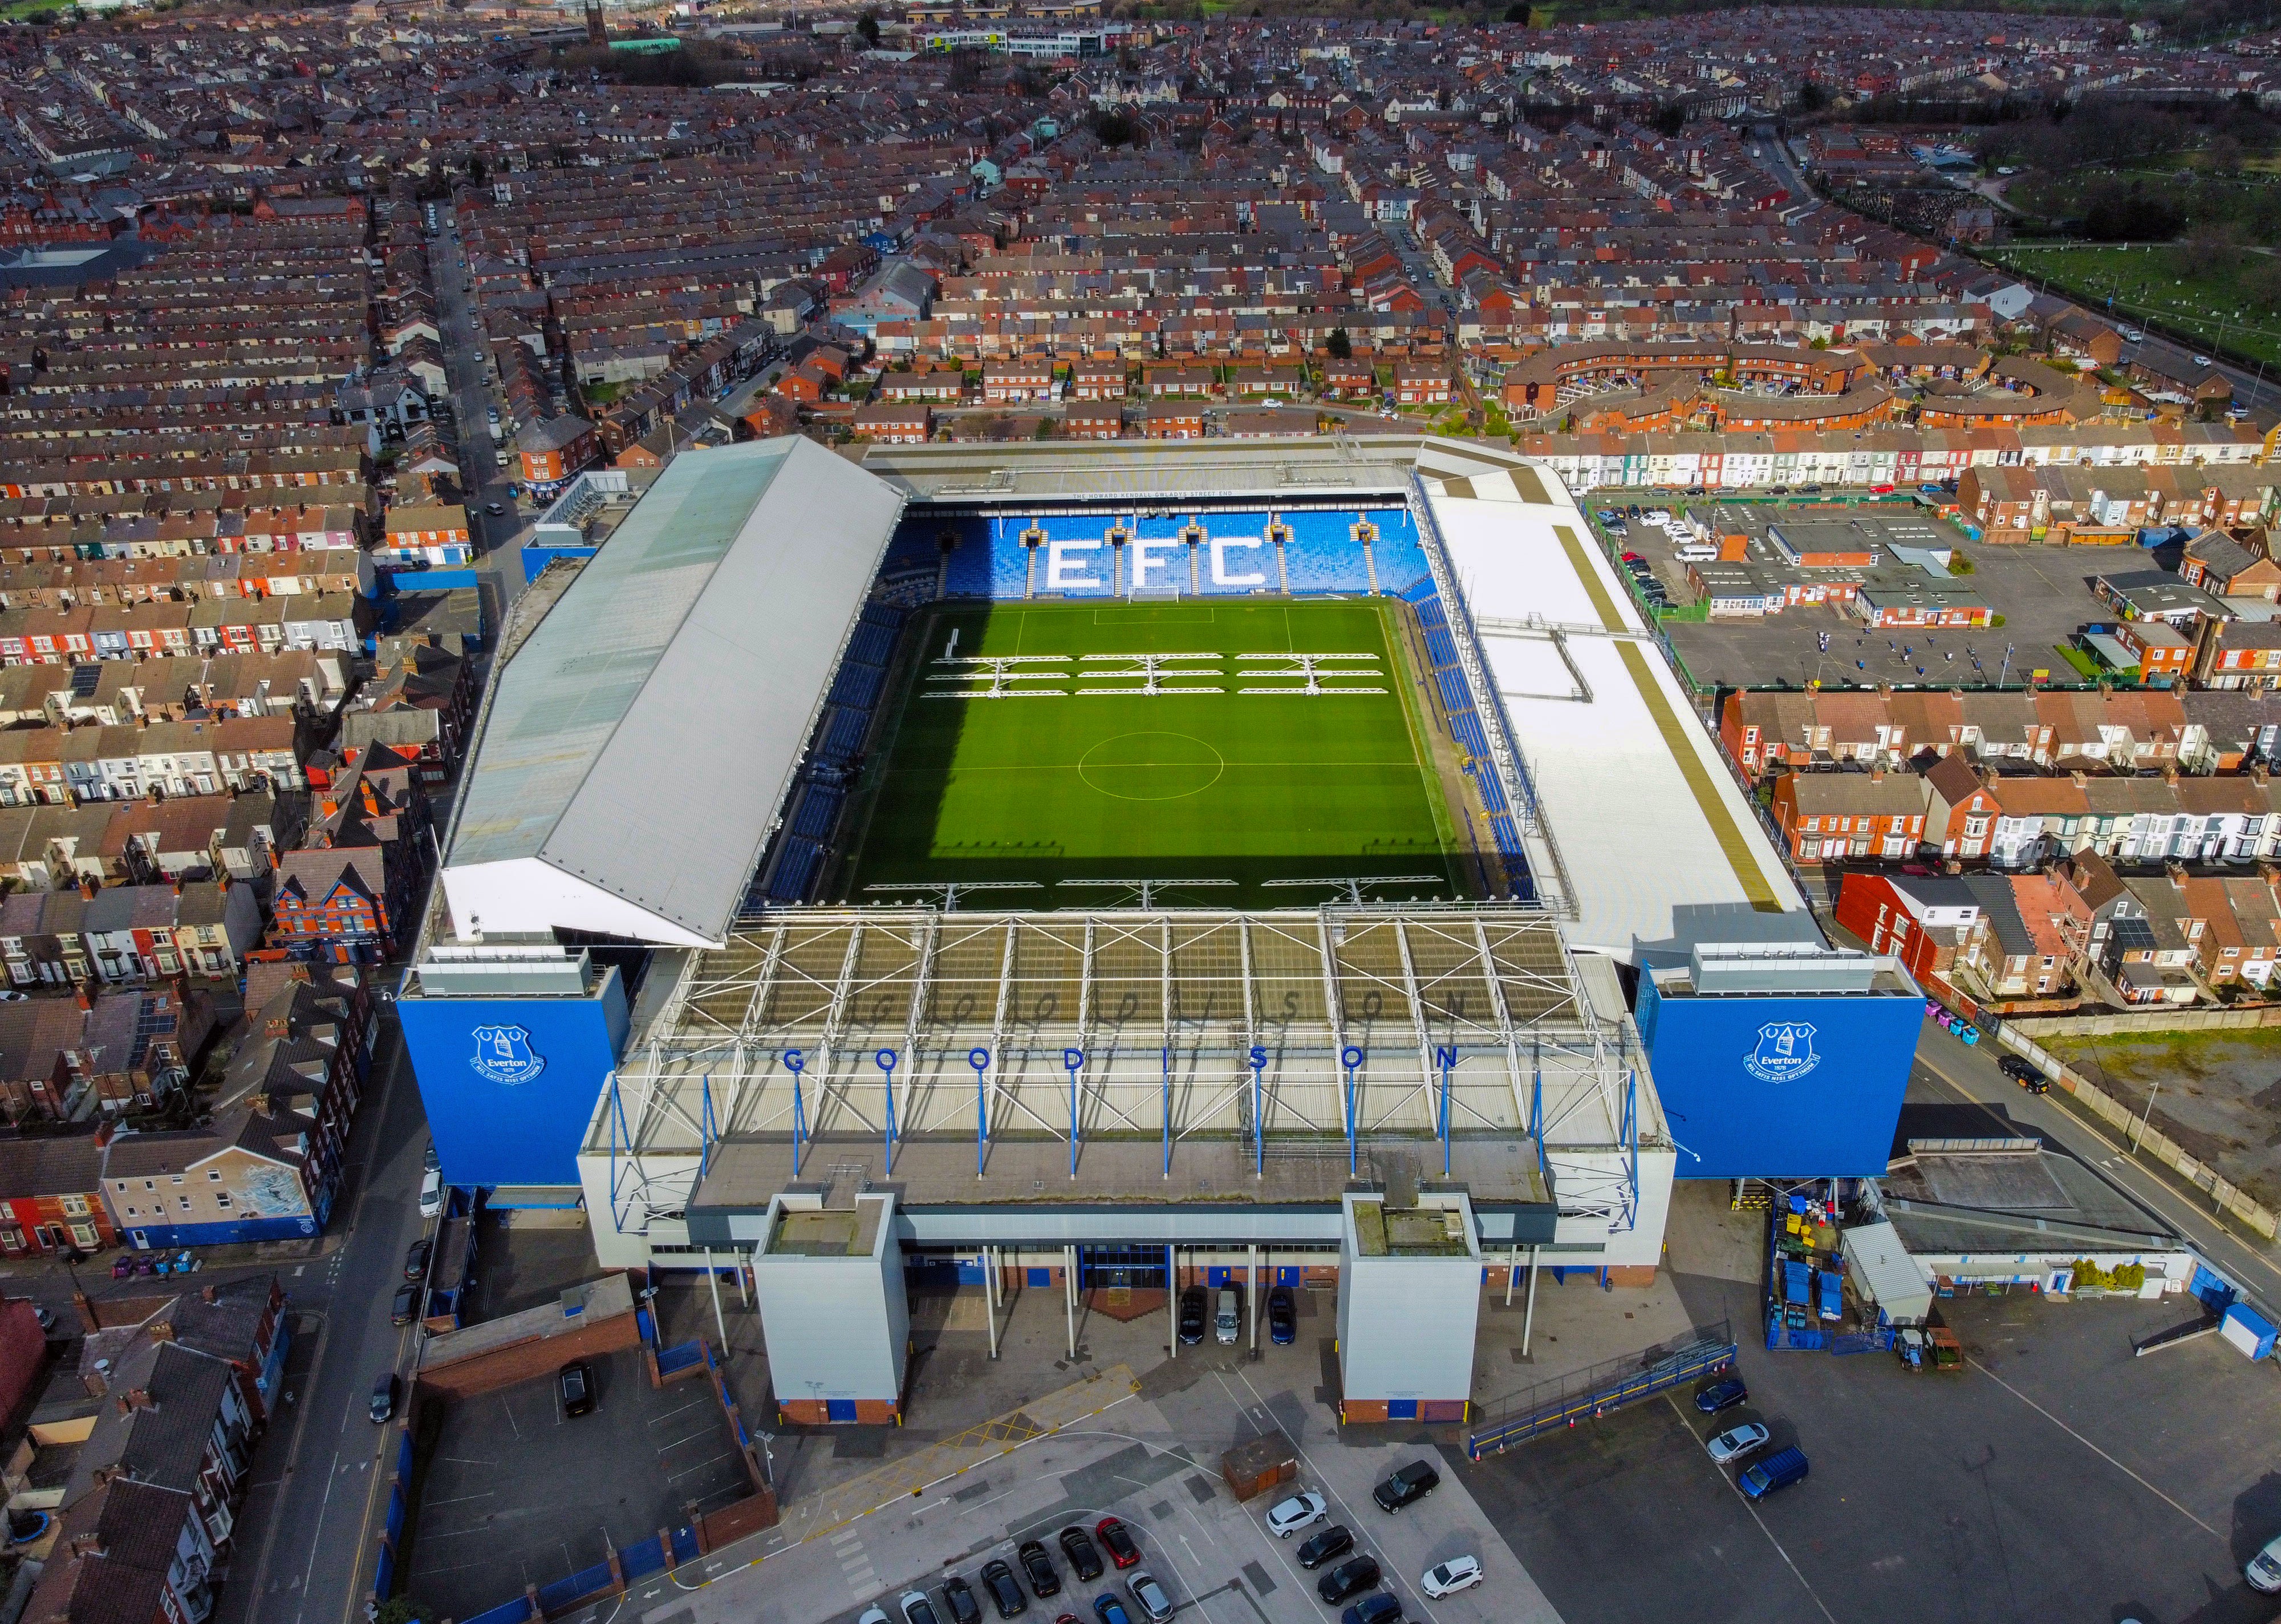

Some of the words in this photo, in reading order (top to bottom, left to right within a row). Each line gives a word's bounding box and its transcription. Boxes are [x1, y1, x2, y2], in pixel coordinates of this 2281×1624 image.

[1048, 538, 1265, 587] EFC
[784, 1046, 1458, 1071] GOODISON
[476, 1065, 485, 1074] NIL
[486, 1073, 503, 1082] SATIS
[1747, 1062, 1756, 1072] NIL
[1754, 1070, 1770, 1079] SATIS
[1787, 1062, 1815, 1079] OPTIMUM
